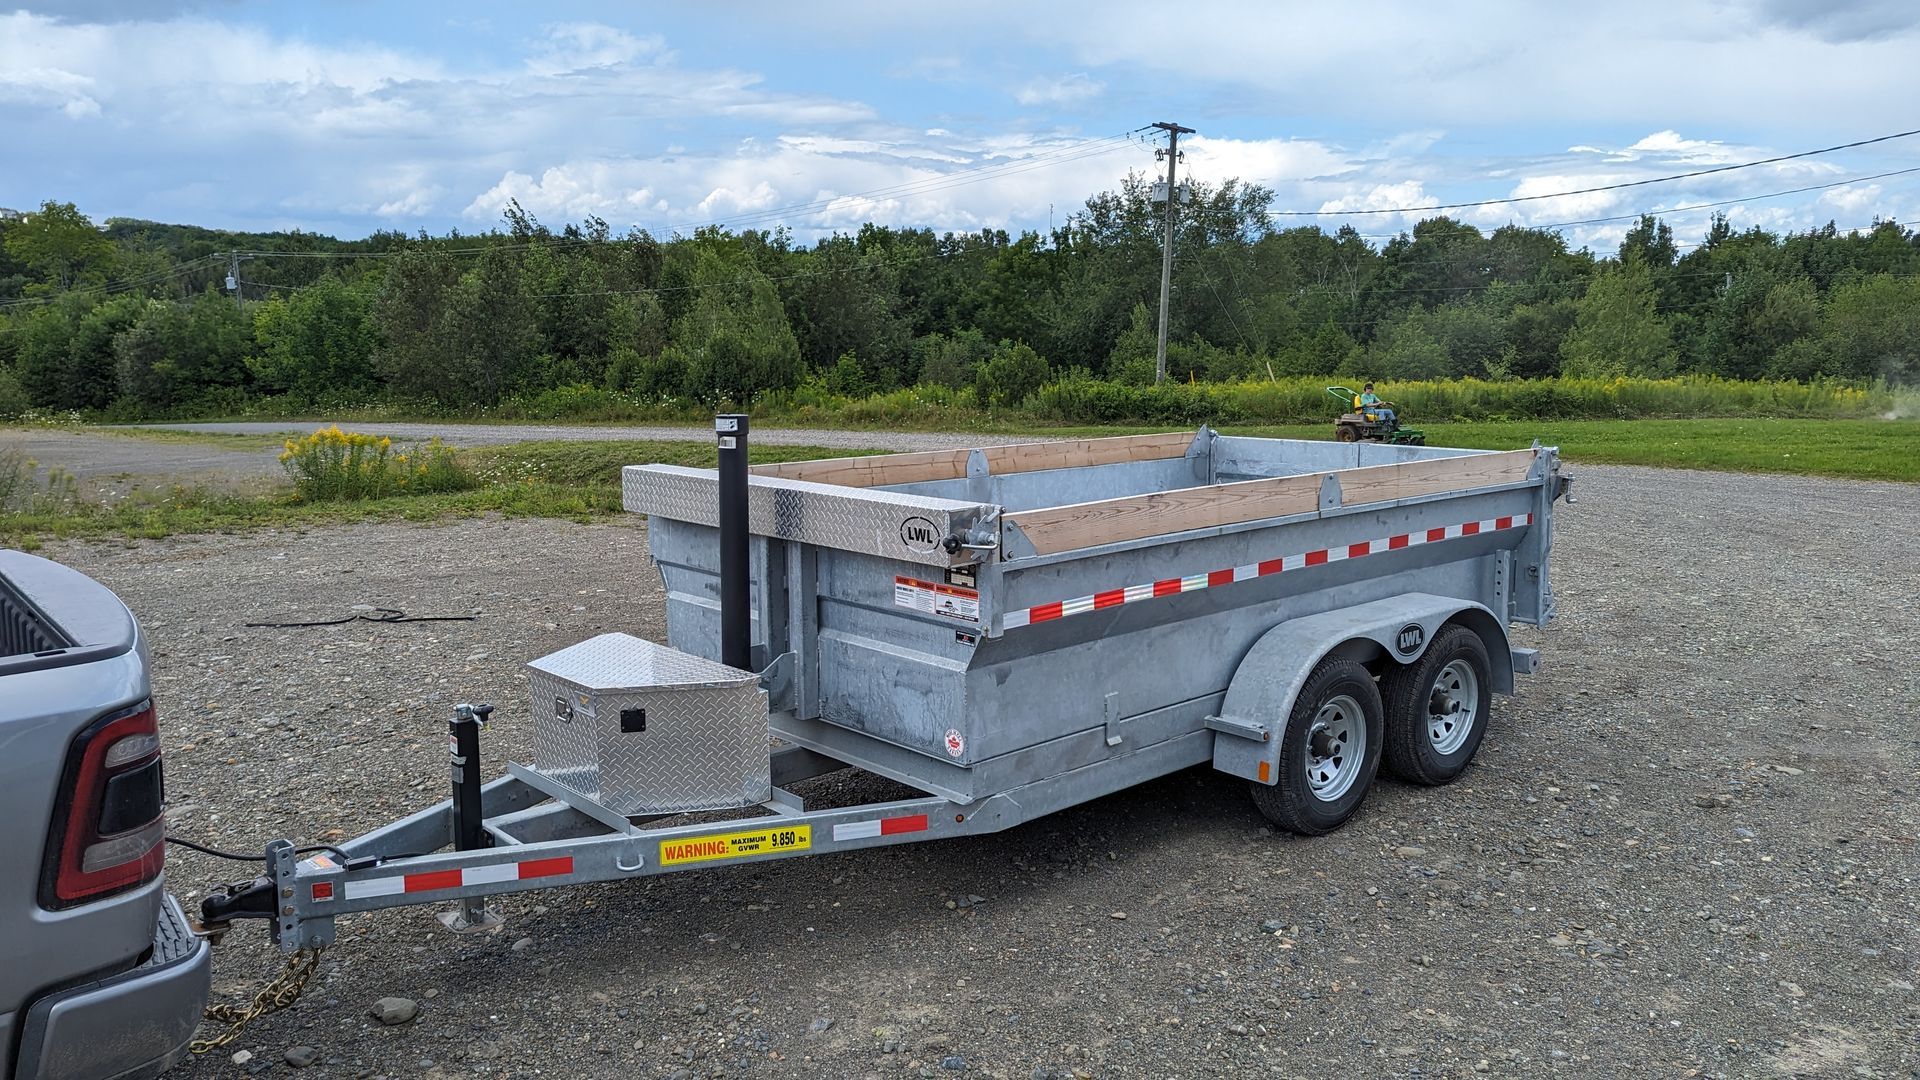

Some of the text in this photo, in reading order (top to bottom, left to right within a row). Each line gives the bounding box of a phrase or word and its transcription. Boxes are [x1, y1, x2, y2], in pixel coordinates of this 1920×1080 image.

[907, 526, 933, 544] LWL
[1400, 630, 1421, 649] LWL
[731, 836, 766, 845] MAXIMUM
[798, 835, 807, 843] lbs
[665, 841, 729, 860] WARNING:
[738, 844, 760, 852] GVWR
